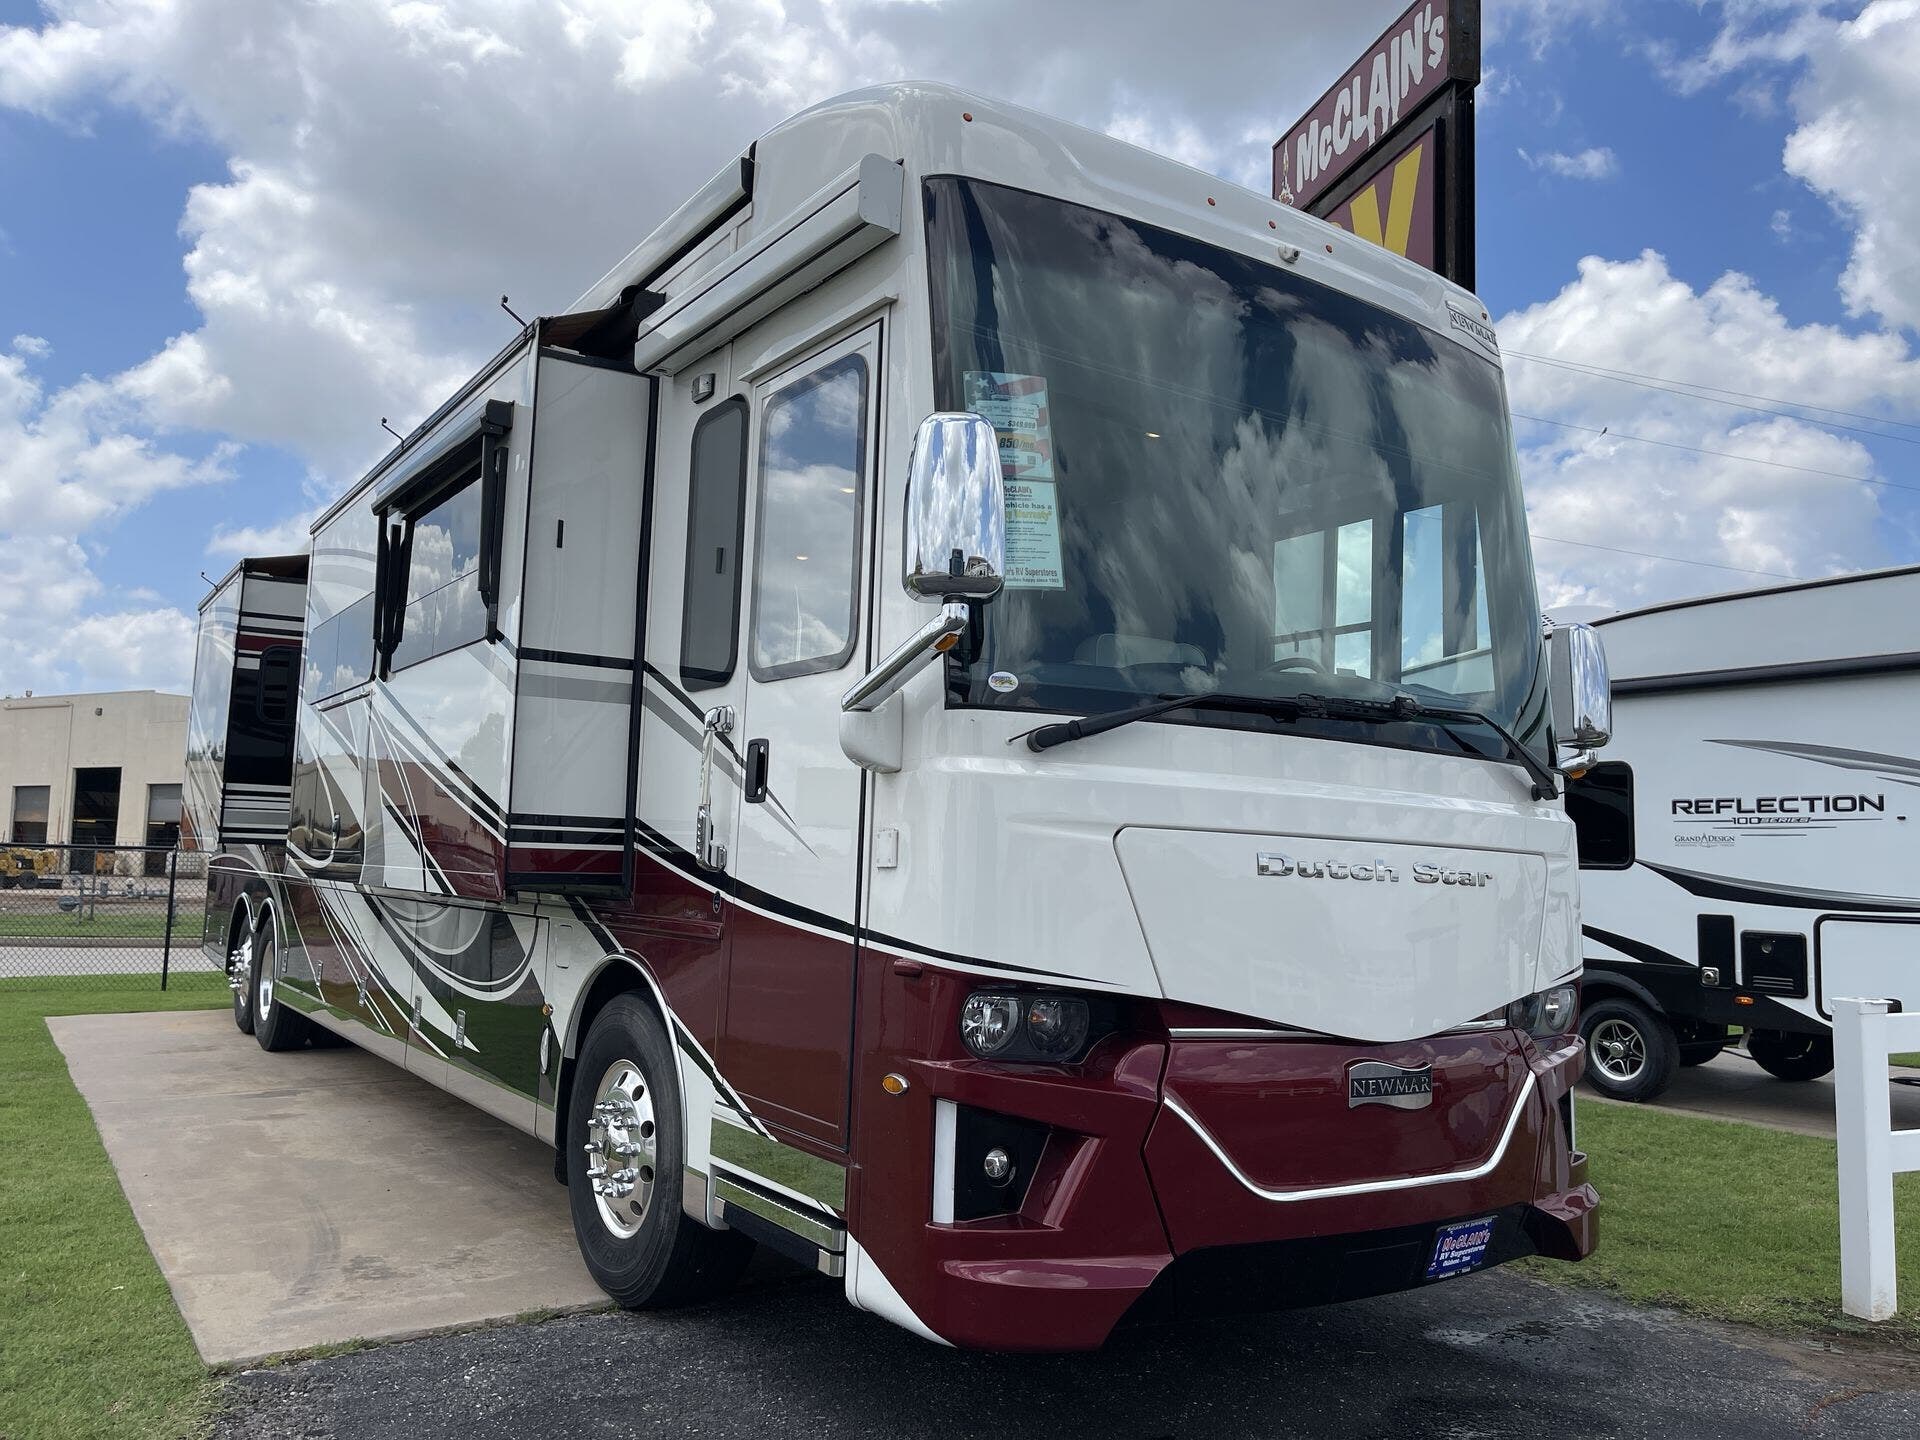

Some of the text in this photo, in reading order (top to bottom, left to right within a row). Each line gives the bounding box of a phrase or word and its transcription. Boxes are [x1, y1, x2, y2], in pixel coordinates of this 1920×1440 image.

[1297, 3, 1445, 193] McCLAIN's
[1350, 144, 1423, 257] V
[1671, 793, 1885, 815] REFLECTION
[1257, 852, 1493, 888] Dutch Star
[1353, 1076, 1430, 1097] NEWMAR
